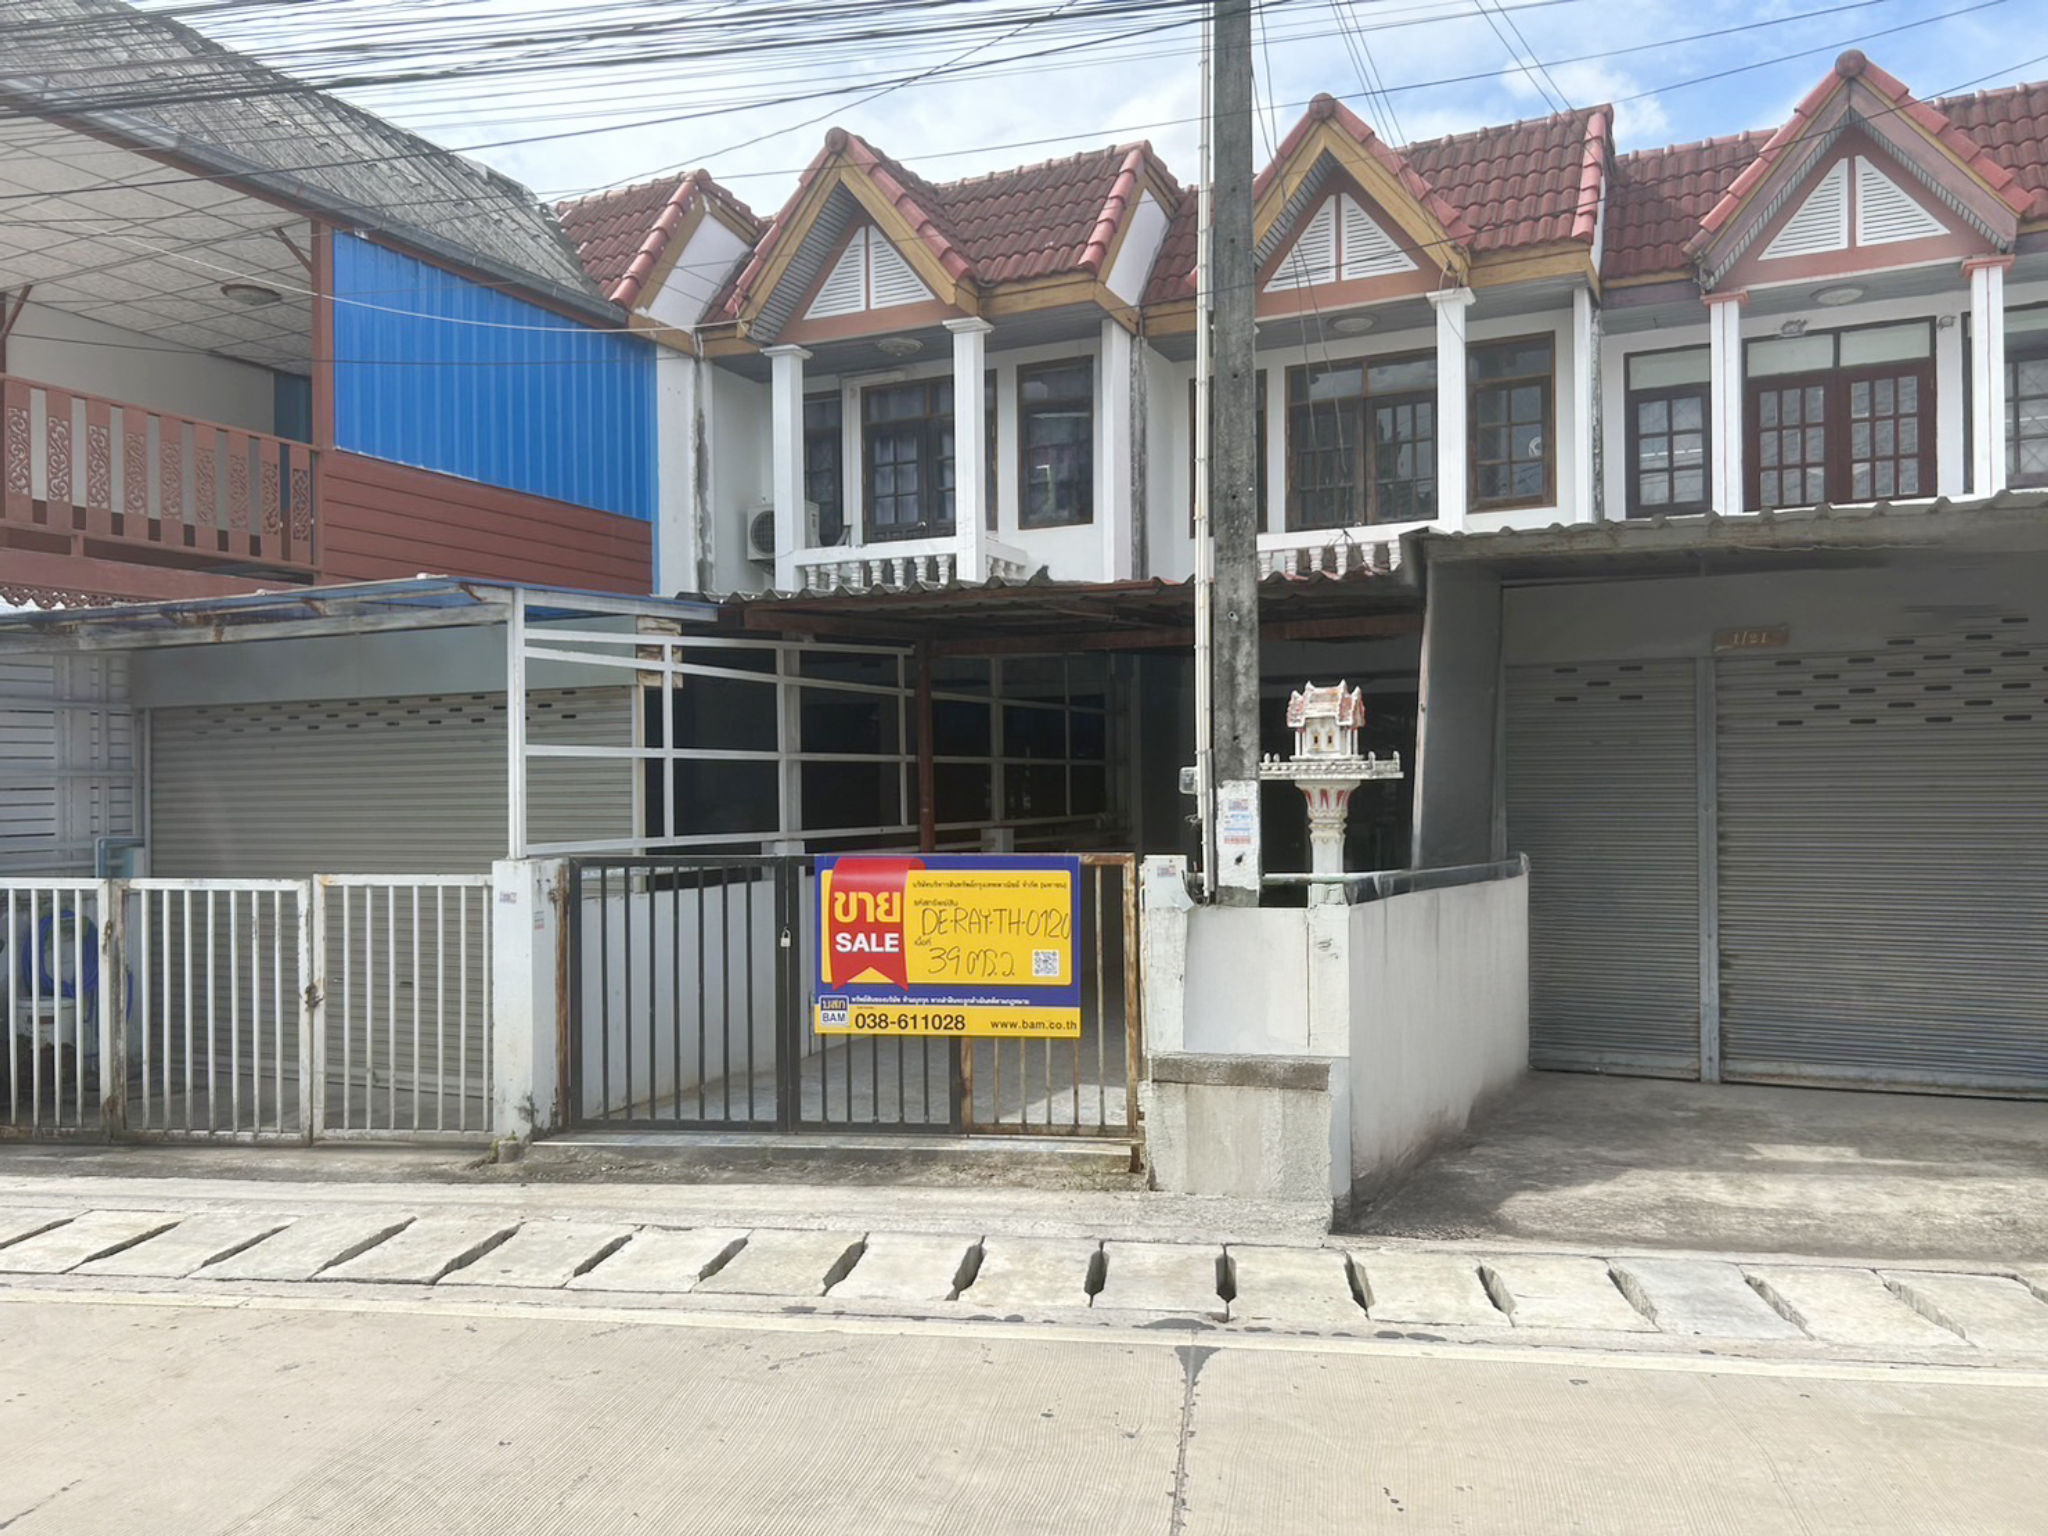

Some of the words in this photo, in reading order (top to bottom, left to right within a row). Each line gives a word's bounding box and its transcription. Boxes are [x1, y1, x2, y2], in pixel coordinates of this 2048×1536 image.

[833, 891, 900, 923] ขาย
[835, 932, 900, 953] SALE
[927, 946, 961, 976] 39
[822, 1012, 846, 1022] BAM
[855, 1013, 966, 1030] 038-611028
[990, 1019, 1077, 1030] www.bam.co.th
